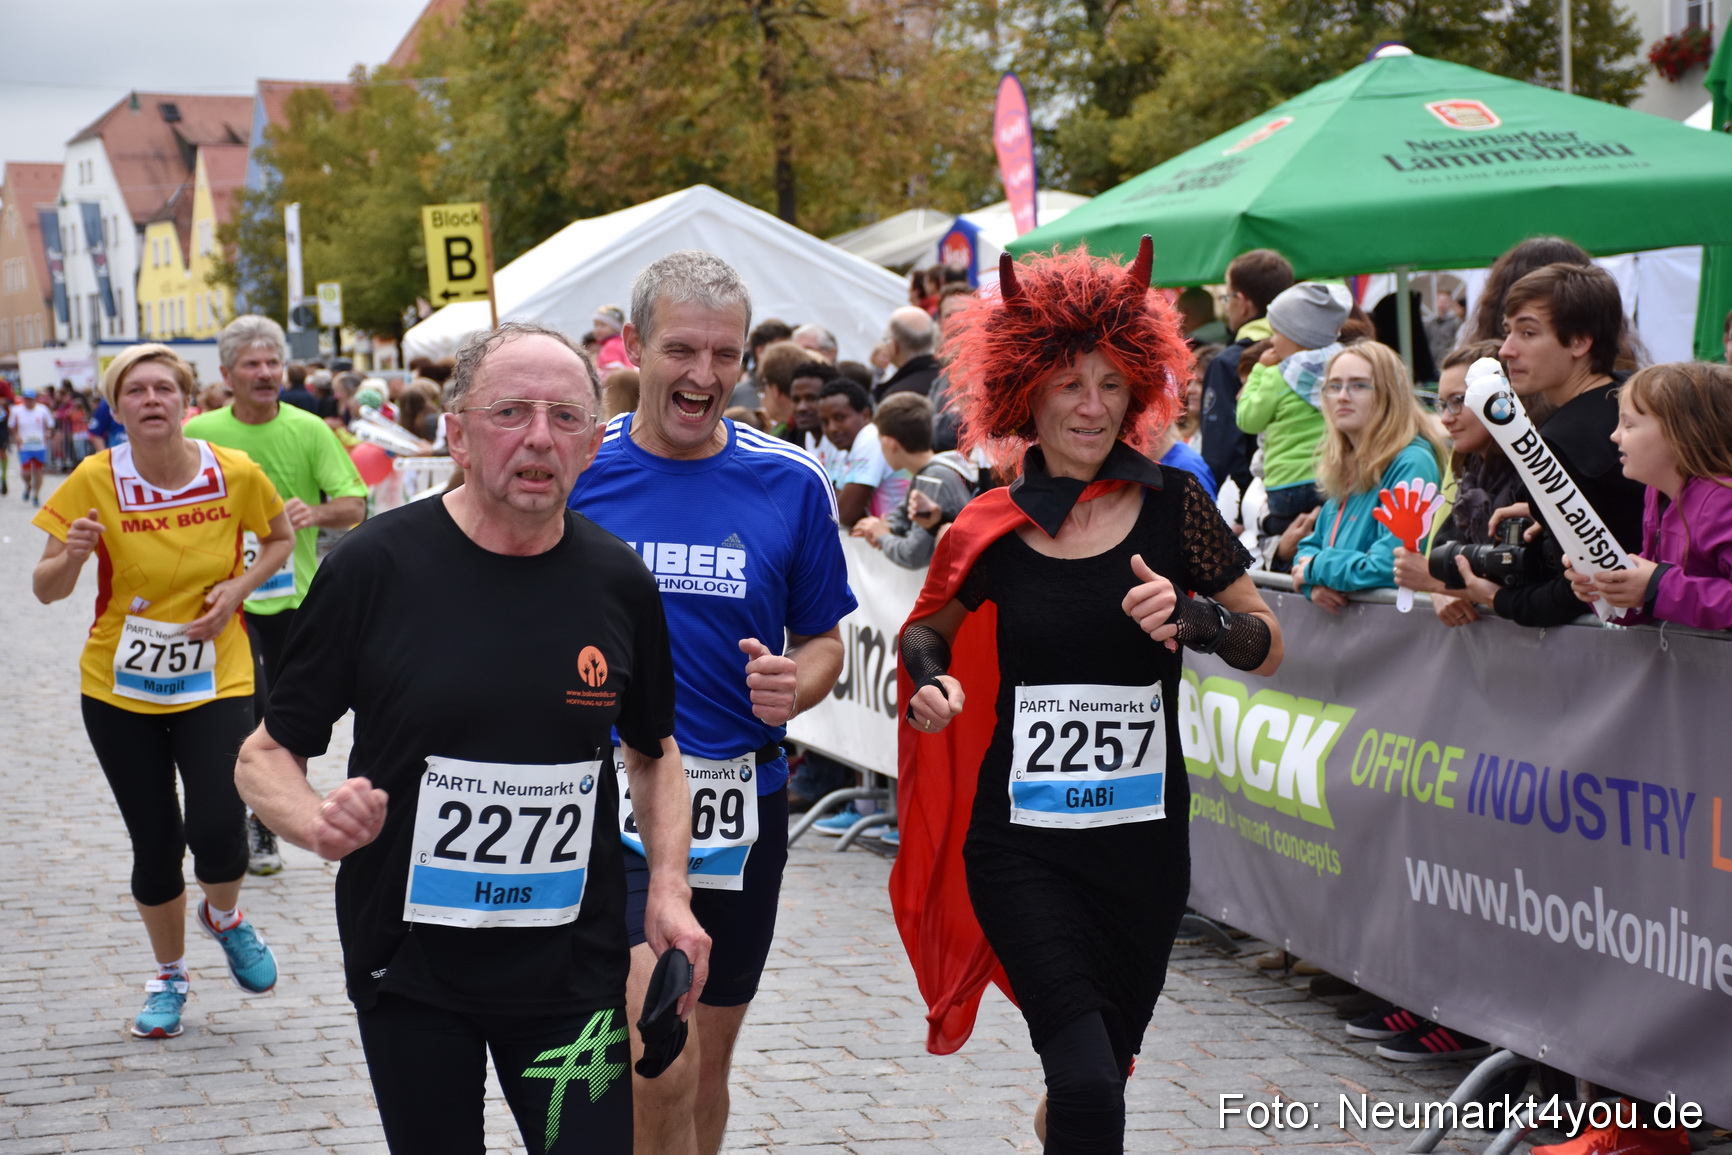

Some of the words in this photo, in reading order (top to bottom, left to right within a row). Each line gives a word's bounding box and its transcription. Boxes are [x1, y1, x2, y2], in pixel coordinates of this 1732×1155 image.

[1404, 130, 1578, 152] Neumarkter
[1382, 140, 1636, 172] Lammsbräu
[431, 209, 482, 229] Block
[444, 236, 477, 281] B
[1511, 428, 1569, 495] BMW
[121, 517, 171, 534] MAX
[176, 506, 232, 529] BÖGL
[125, 623, 154, 638] PARTL
[124, 639, 204, 673] 2757
[144, 679, 185, 695] Margit
[1019, 699, 1065, 713] PARTL
[1069, 699, 1145, 713] Neumarkt
[1026, 720, 1155, 773] 2257
[1178, 678, 1341, 810] BOCK
[426, 772, 487, 794] PARTL
[493, 780, 574, 797] Neumarkt
[684, 767, 736, 780] eumarkt
[1066, 787, 1114, 809] GABi
[1350, 728, 1465, 809] OFFICE
[1467, 753, 1697, 860] INDUSTRY
[433, 800, 582, 865] 2272
[1274, 829, 1342, 877] concepts
[474, 881, 533, 905] Hans
